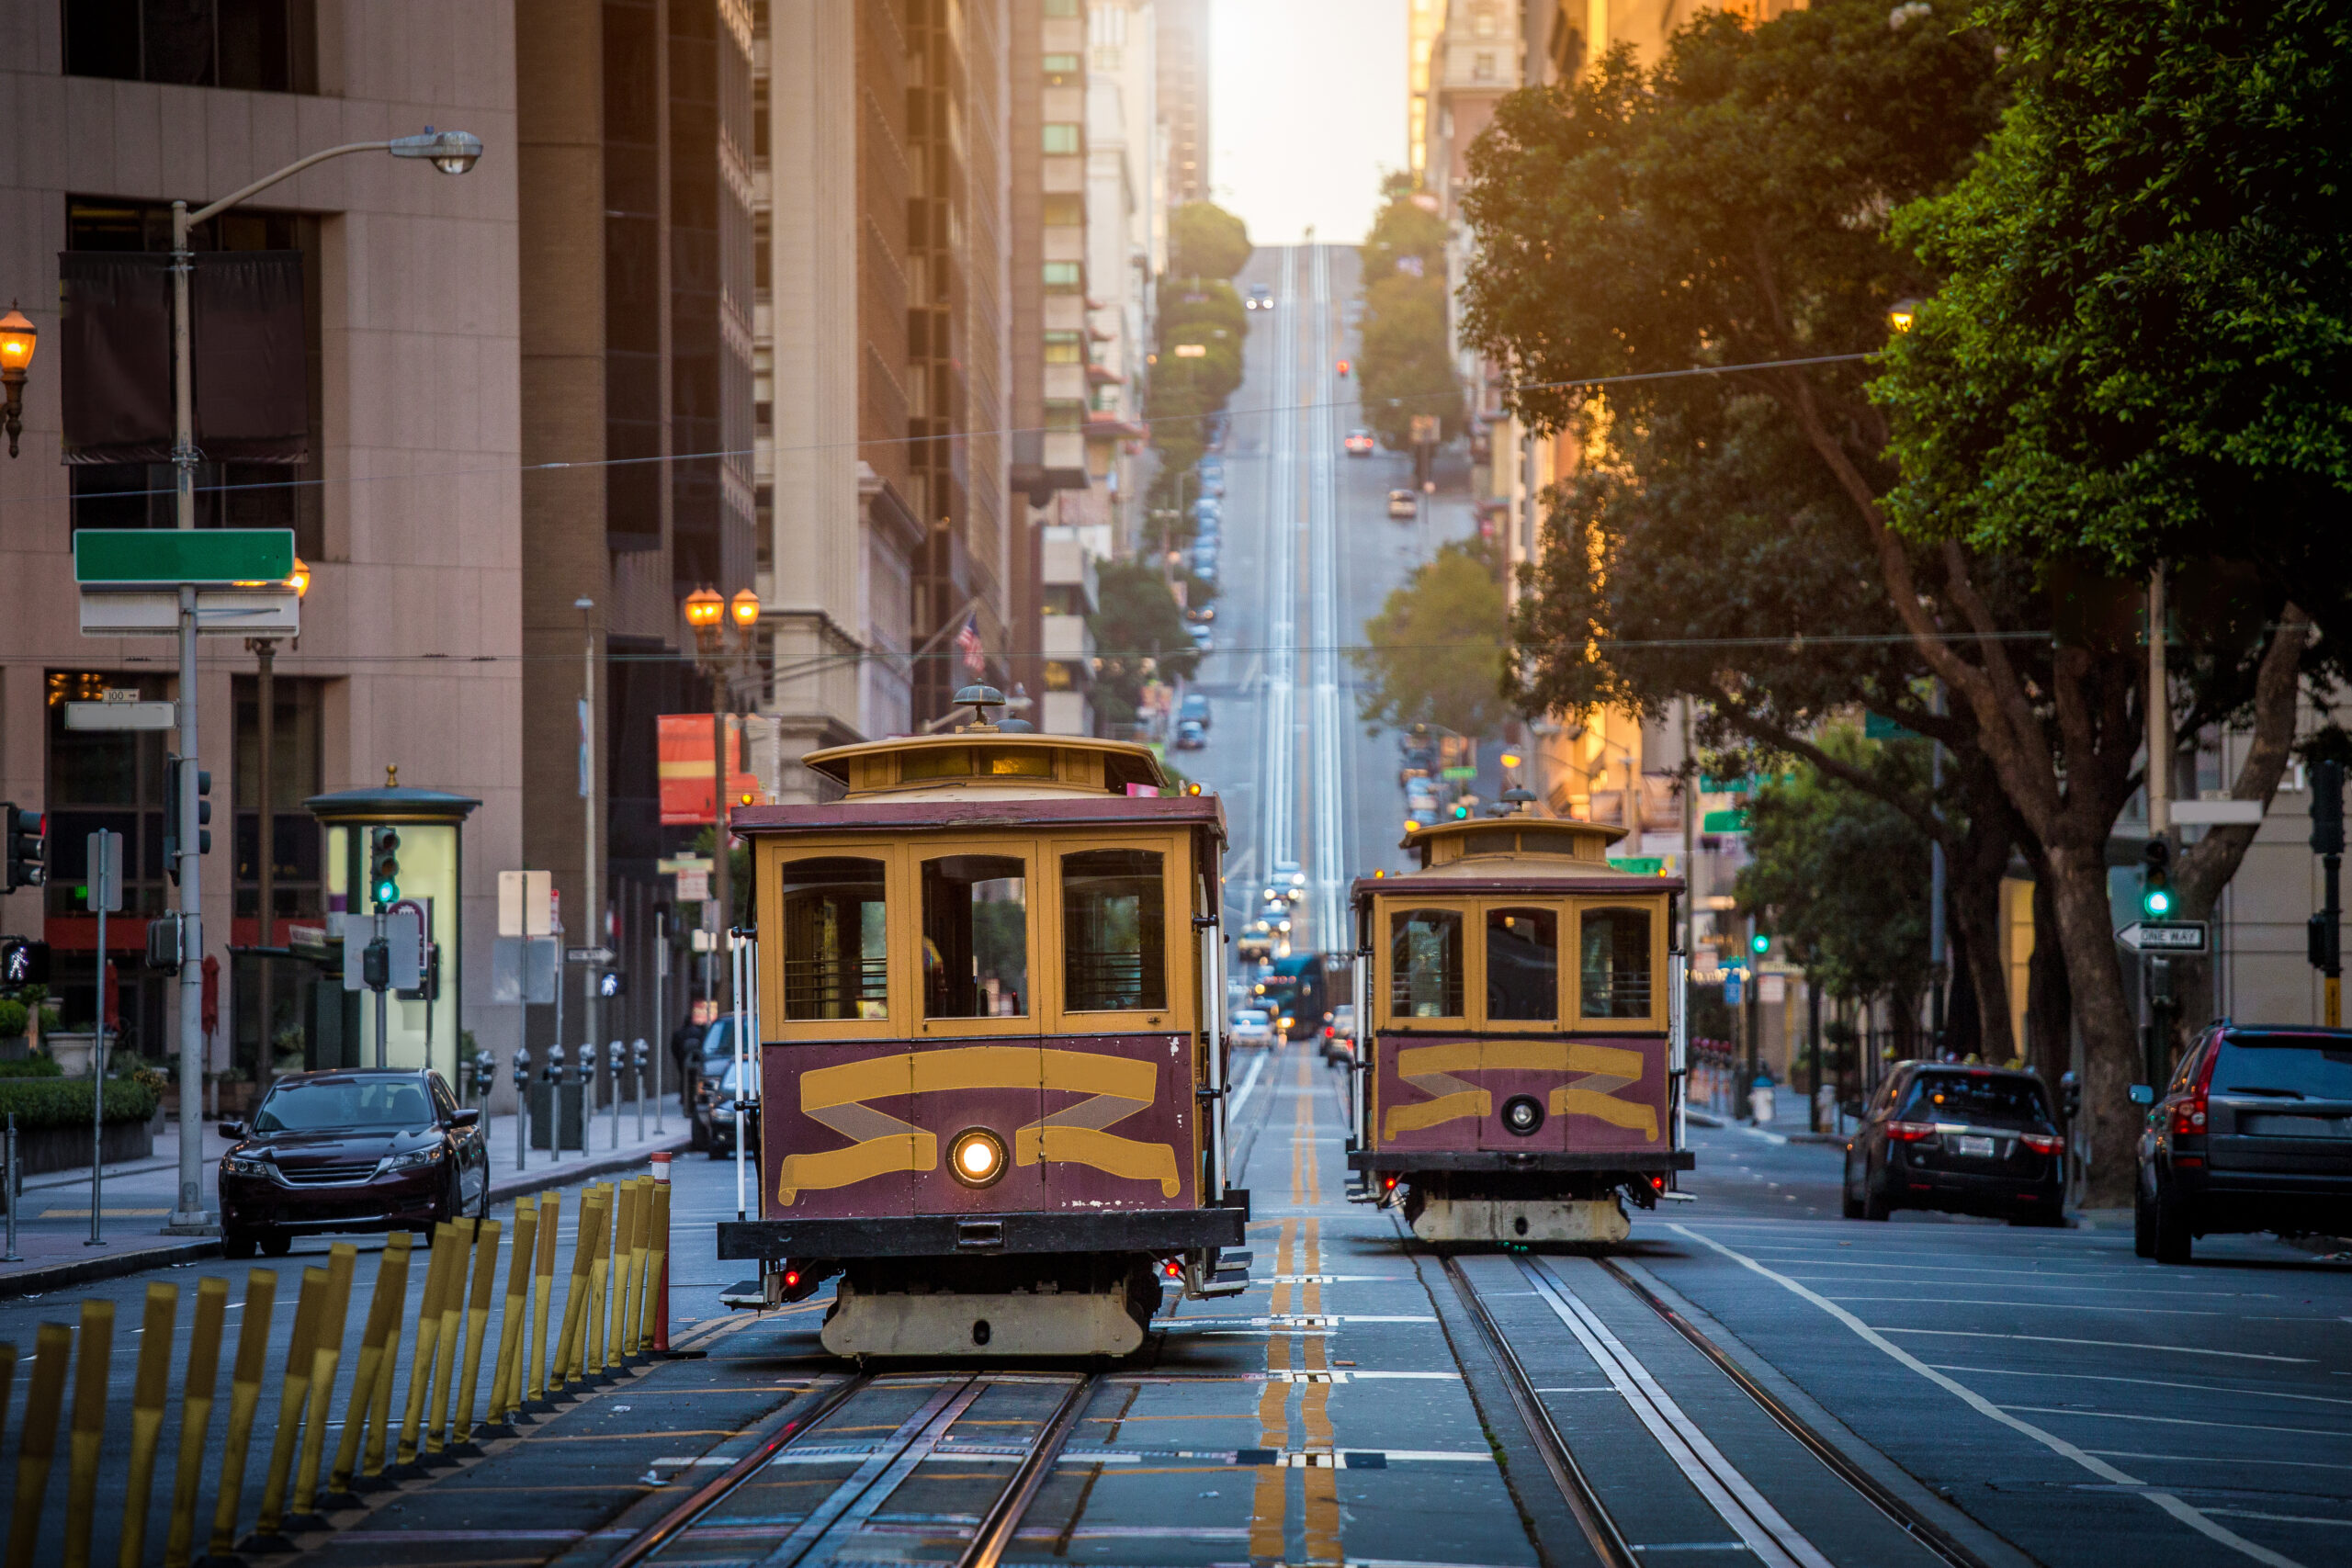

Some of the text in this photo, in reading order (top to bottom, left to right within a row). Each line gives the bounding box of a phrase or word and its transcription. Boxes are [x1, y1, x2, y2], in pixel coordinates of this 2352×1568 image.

[108, 691, 124, 699] 100
[2141, 929, 2195, 942] ONE WAY
